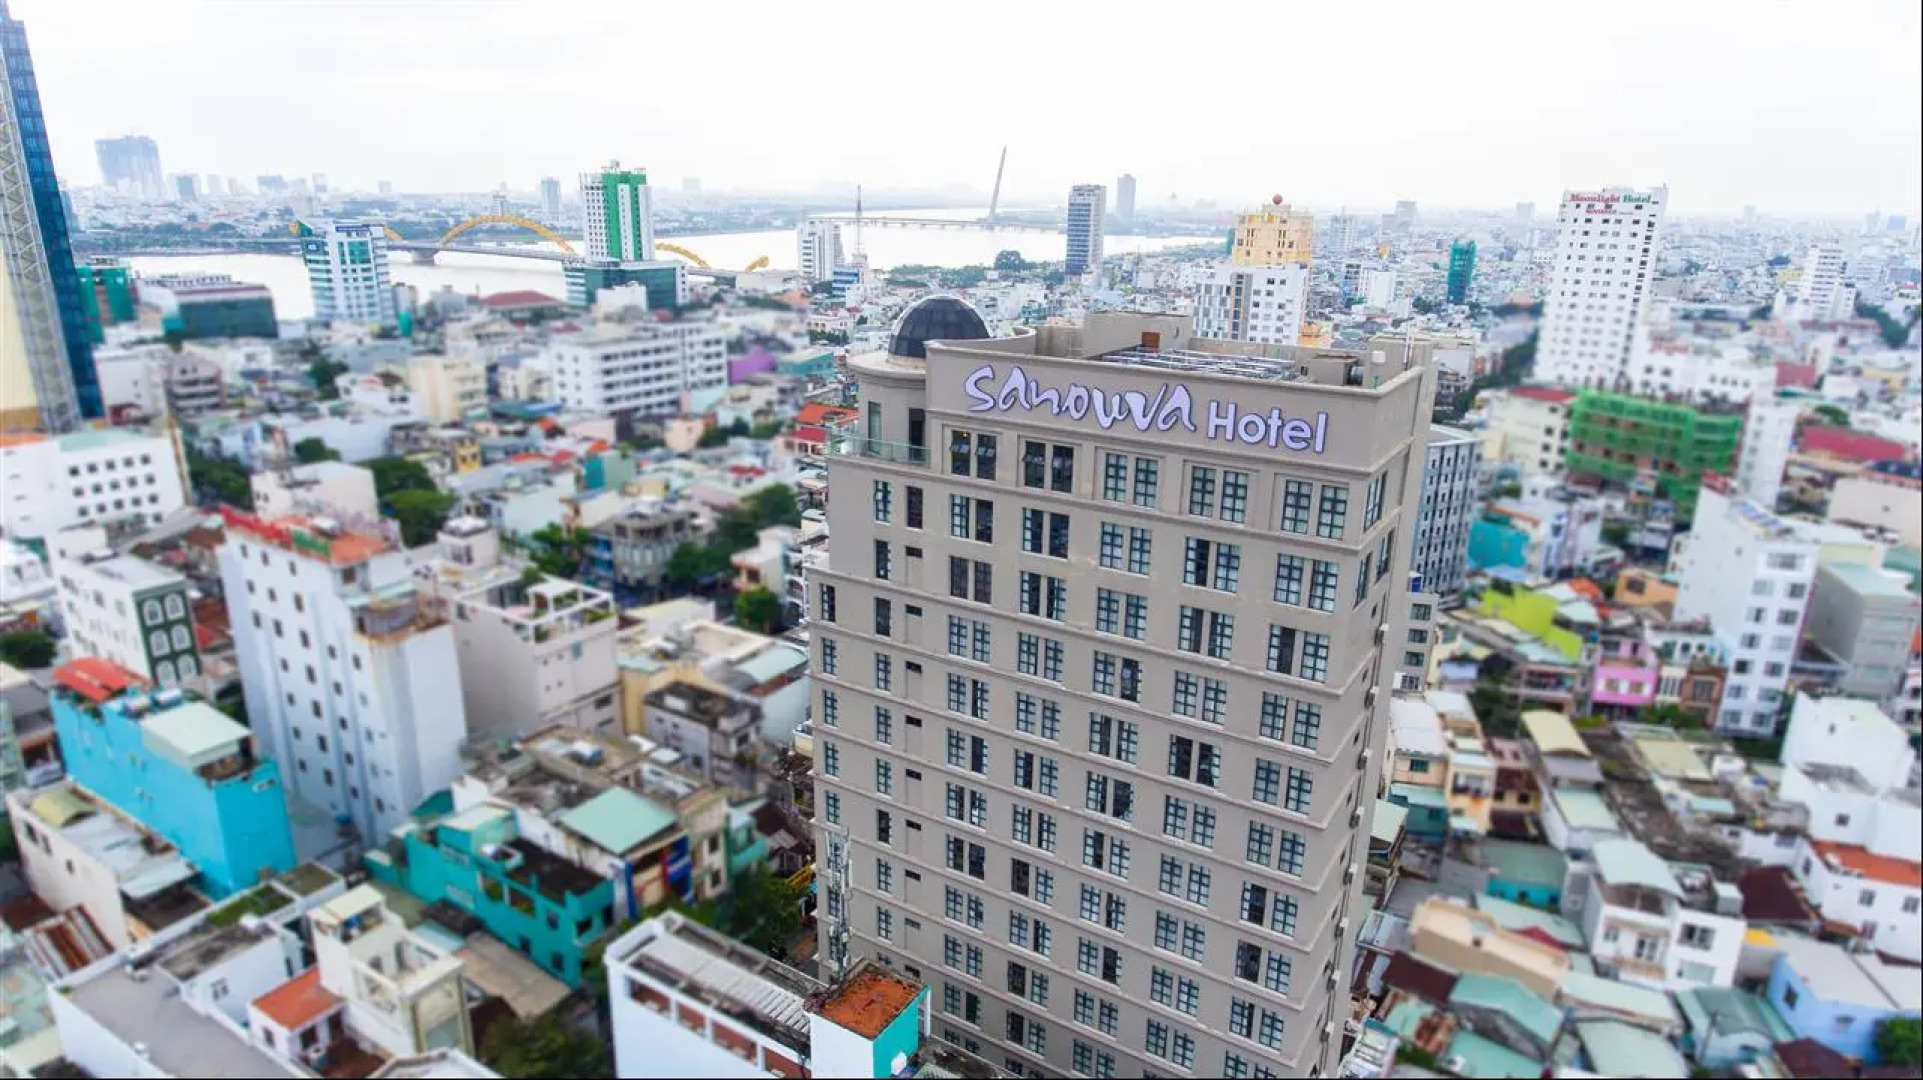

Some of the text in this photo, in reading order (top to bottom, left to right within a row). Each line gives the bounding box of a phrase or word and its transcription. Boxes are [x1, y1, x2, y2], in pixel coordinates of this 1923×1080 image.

[1570, 193, 1651, 203] Moonlight Hotel
[1206, 400, 1329, 454] Hotel
